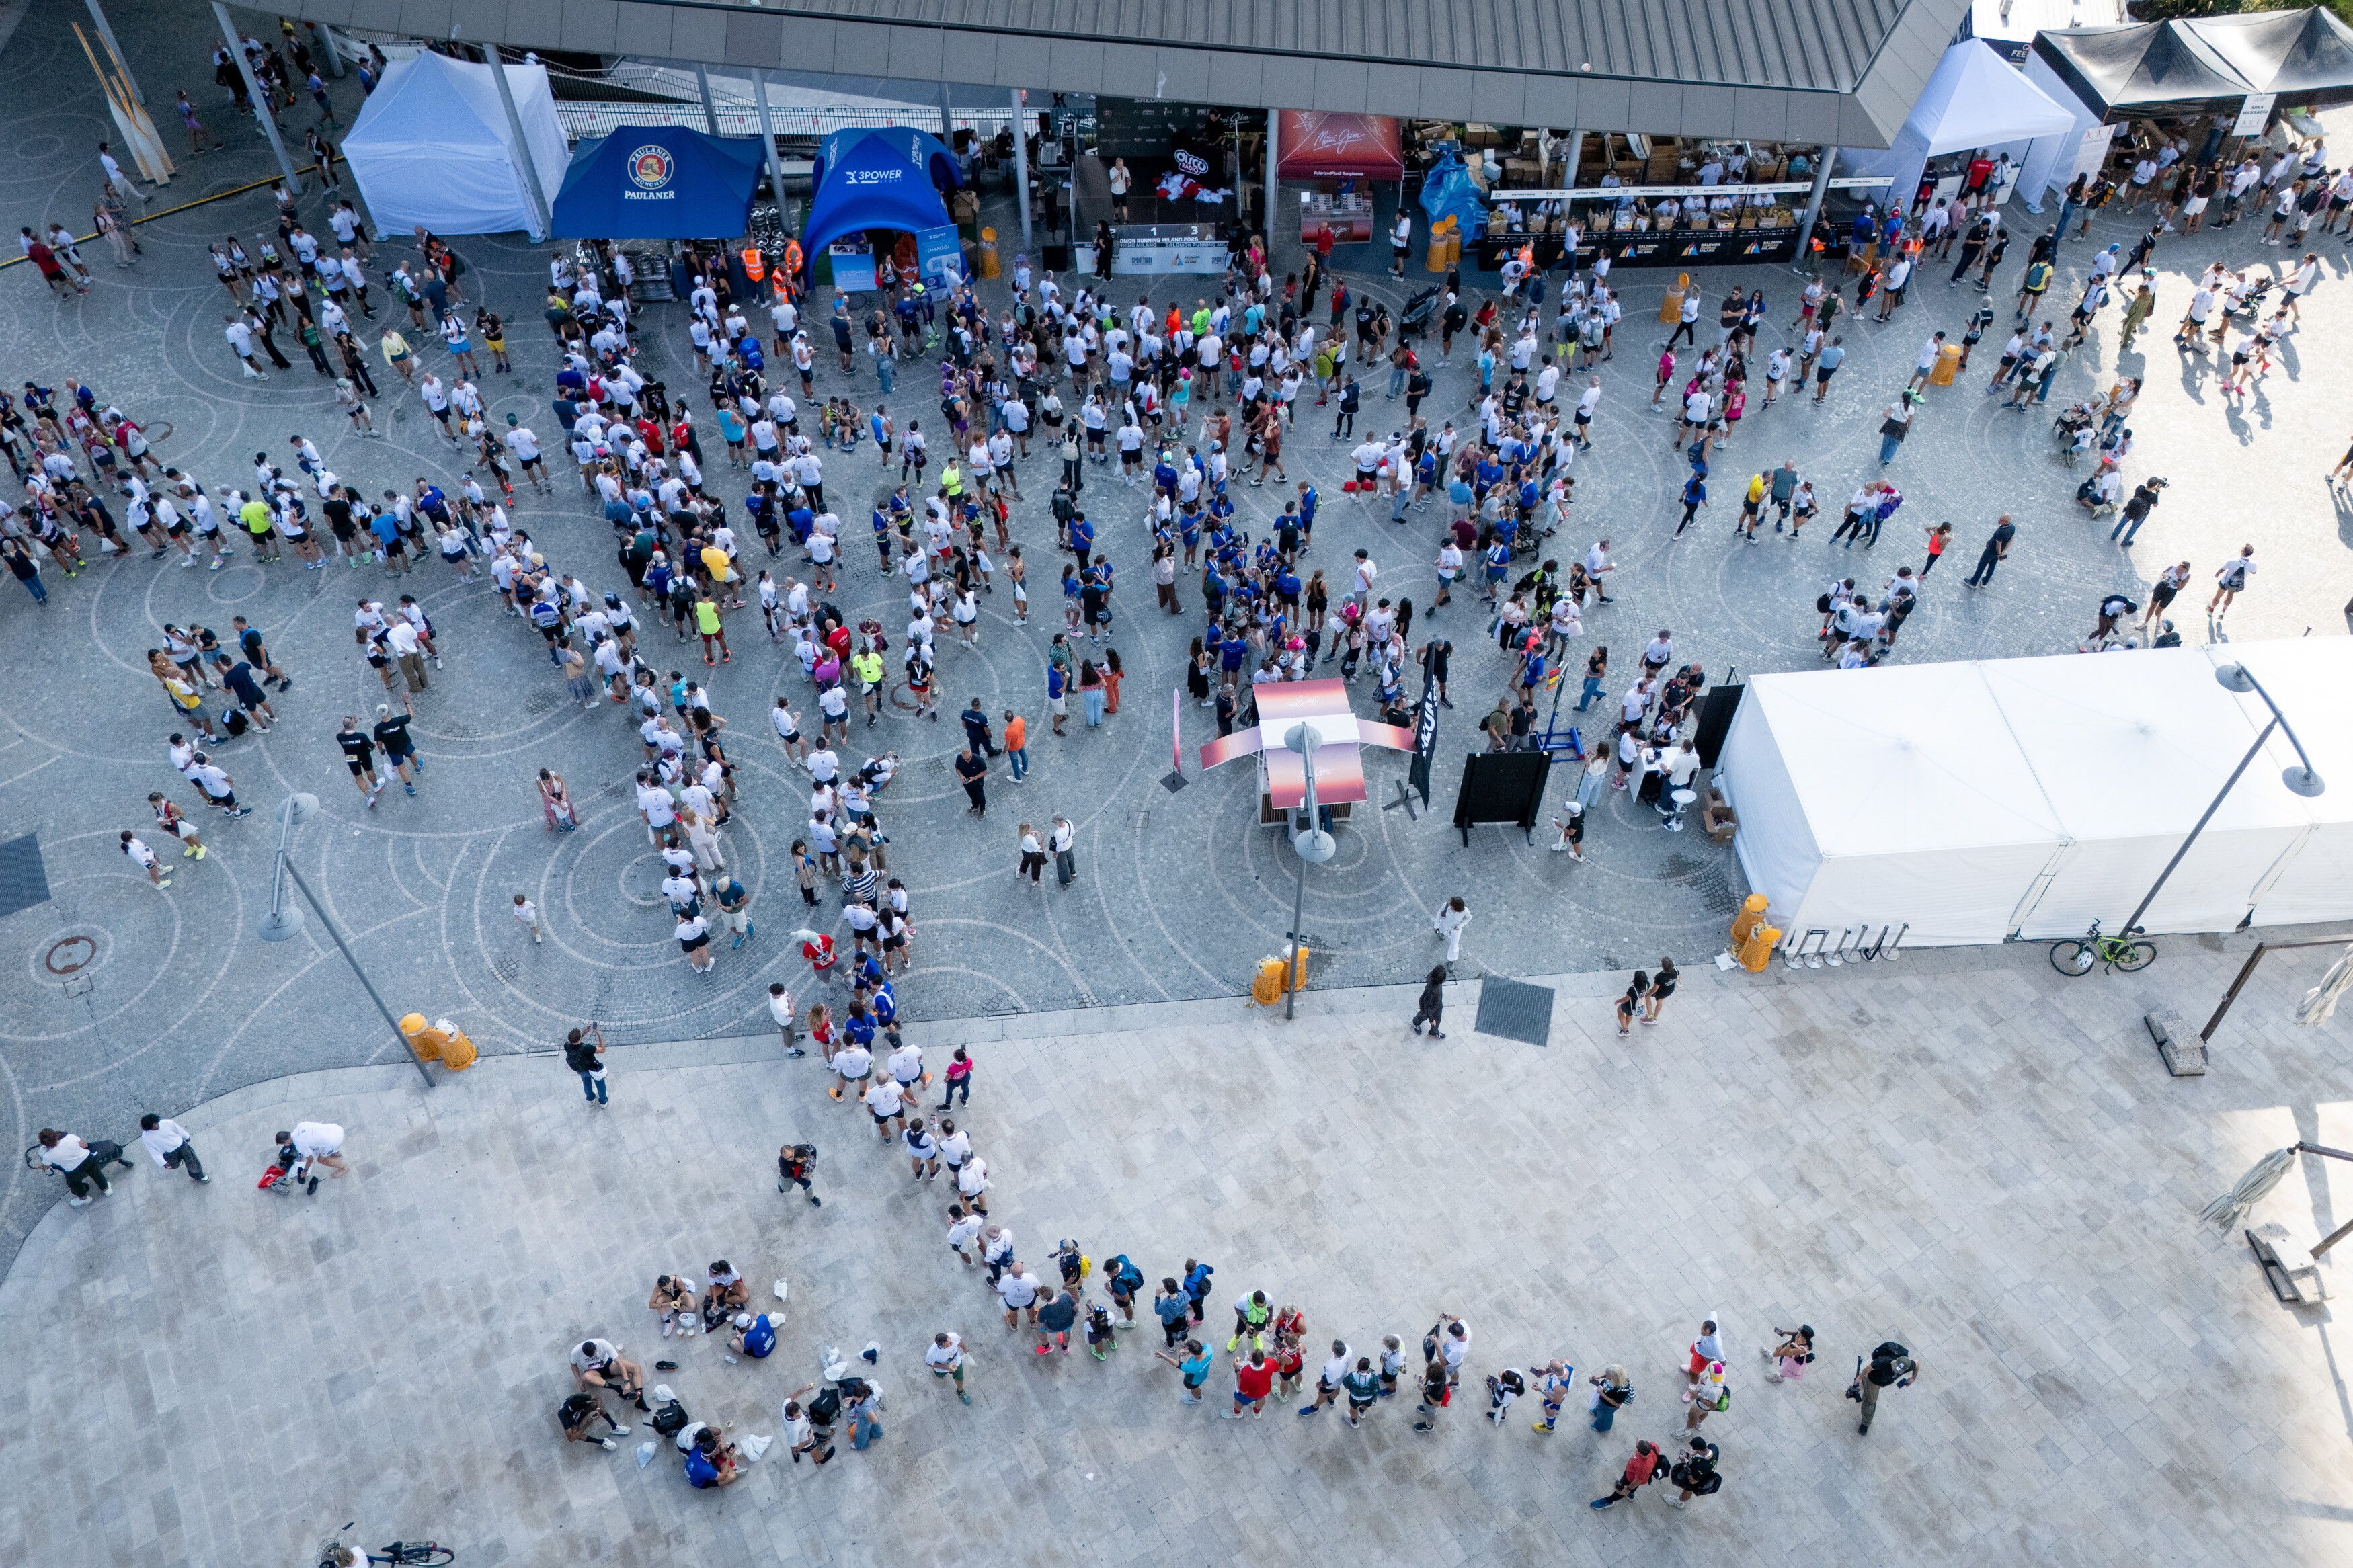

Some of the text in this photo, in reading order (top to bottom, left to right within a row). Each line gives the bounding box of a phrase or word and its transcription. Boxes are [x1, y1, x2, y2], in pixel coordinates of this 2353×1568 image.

[2011, 50, 2028, 58] FEE
[631, 147, 670, 163] PAULANER
[1181, 162, 1199, 173] RADIO
[858, 169, 902, 180] 3POWER
[625, 190, 675, 200] PAULANER
[1150, 227, 1156, 235] 1
[1191, 226, 1198, 235] 3
